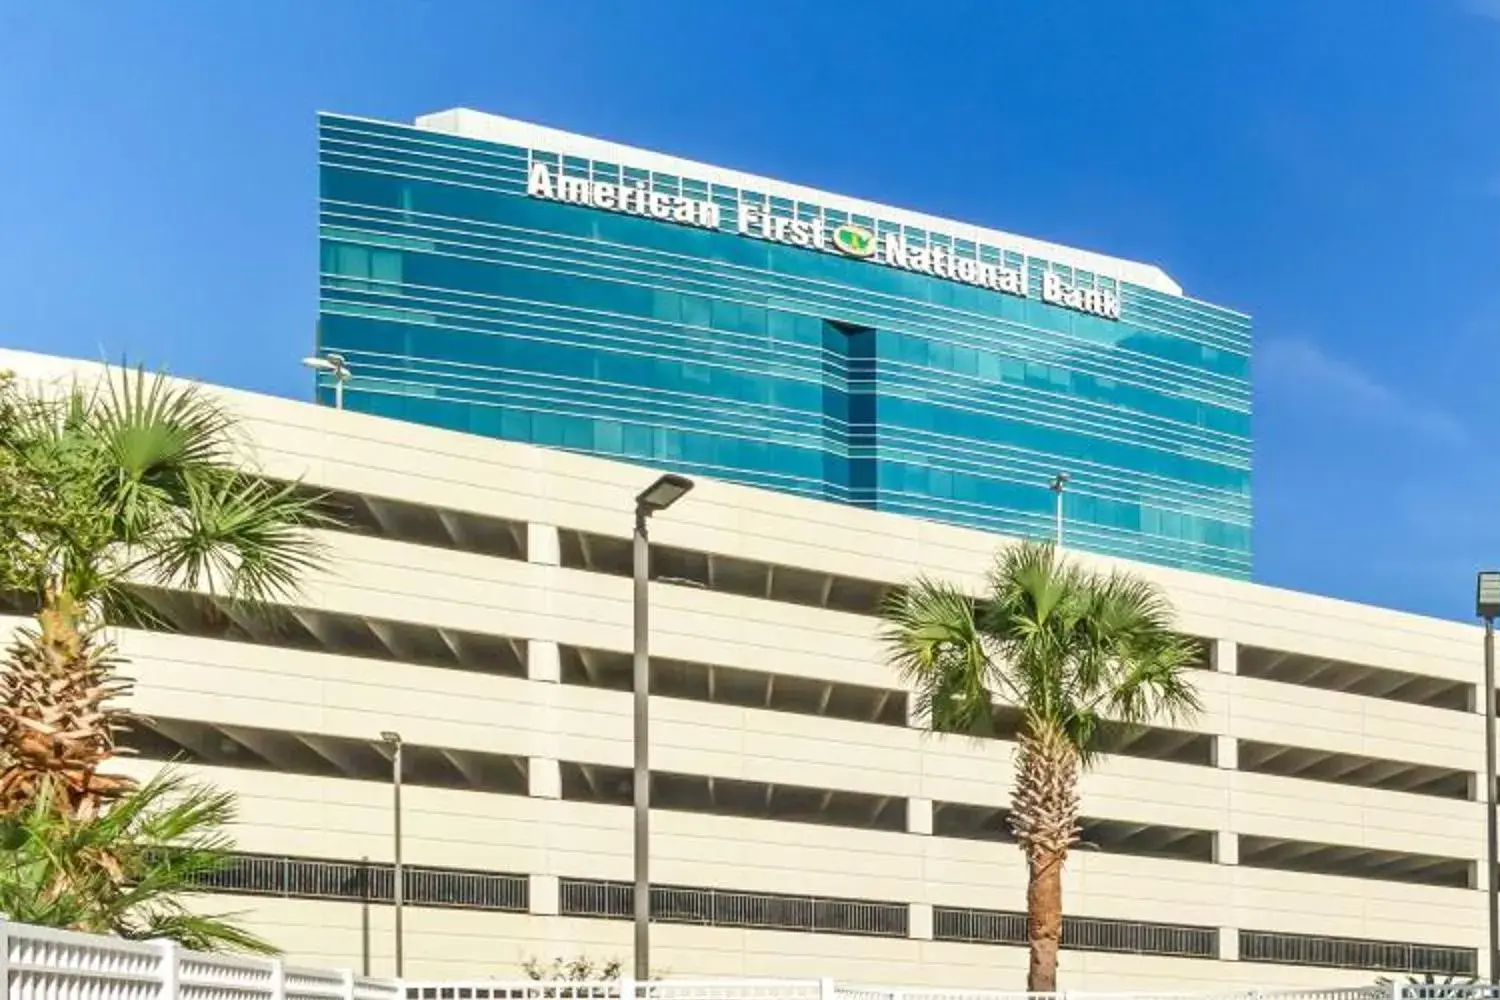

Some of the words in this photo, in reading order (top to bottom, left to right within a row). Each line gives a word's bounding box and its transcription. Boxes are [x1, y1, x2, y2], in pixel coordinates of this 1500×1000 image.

[527, 161, 720, 229] American
[738, 201, 824, 249] First
[886, 232, 1028, 297] National
[1042, 271, 1121, 319] Bank
